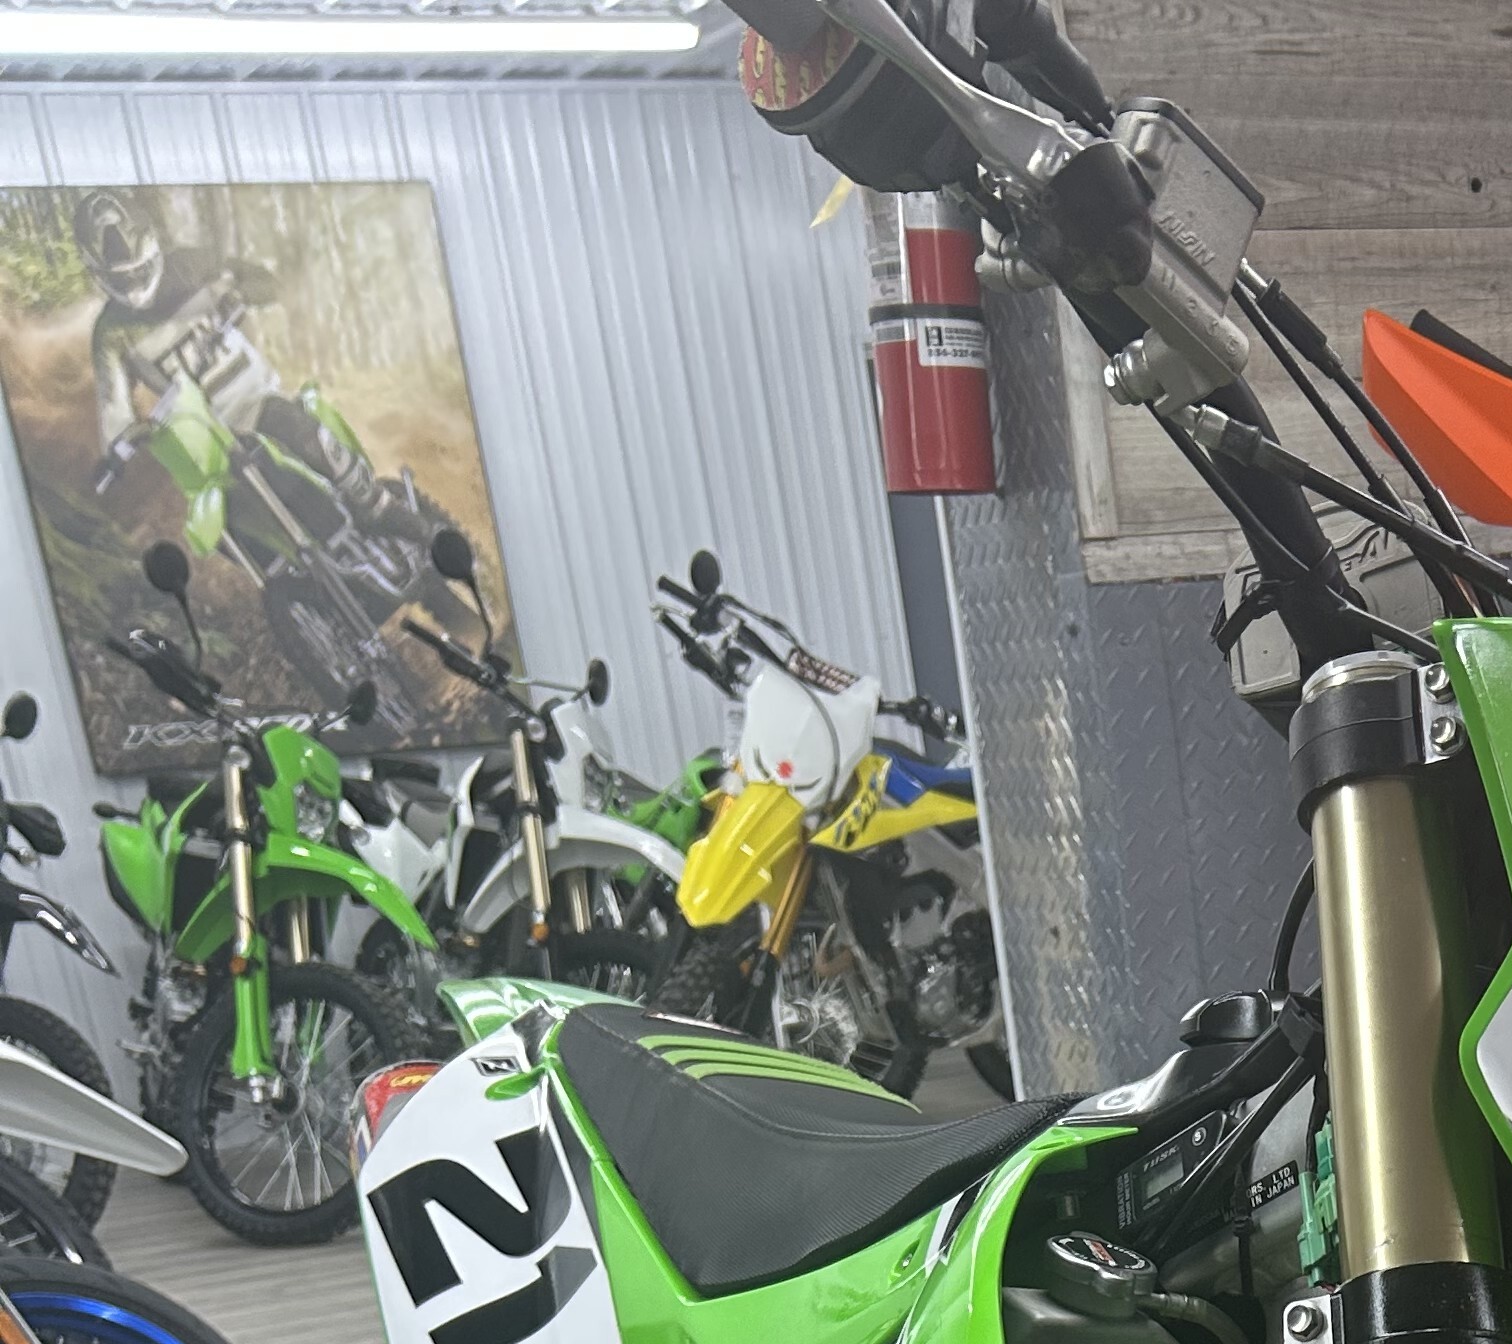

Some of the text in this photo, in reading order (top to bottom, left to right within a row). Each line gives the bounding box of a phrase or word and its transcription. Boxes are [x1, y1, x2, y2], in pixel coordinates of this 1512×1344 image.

[1272, 1166, 1291, 1184] LTD
[1250, 1174, 1295, 1208] IN JAPAN
